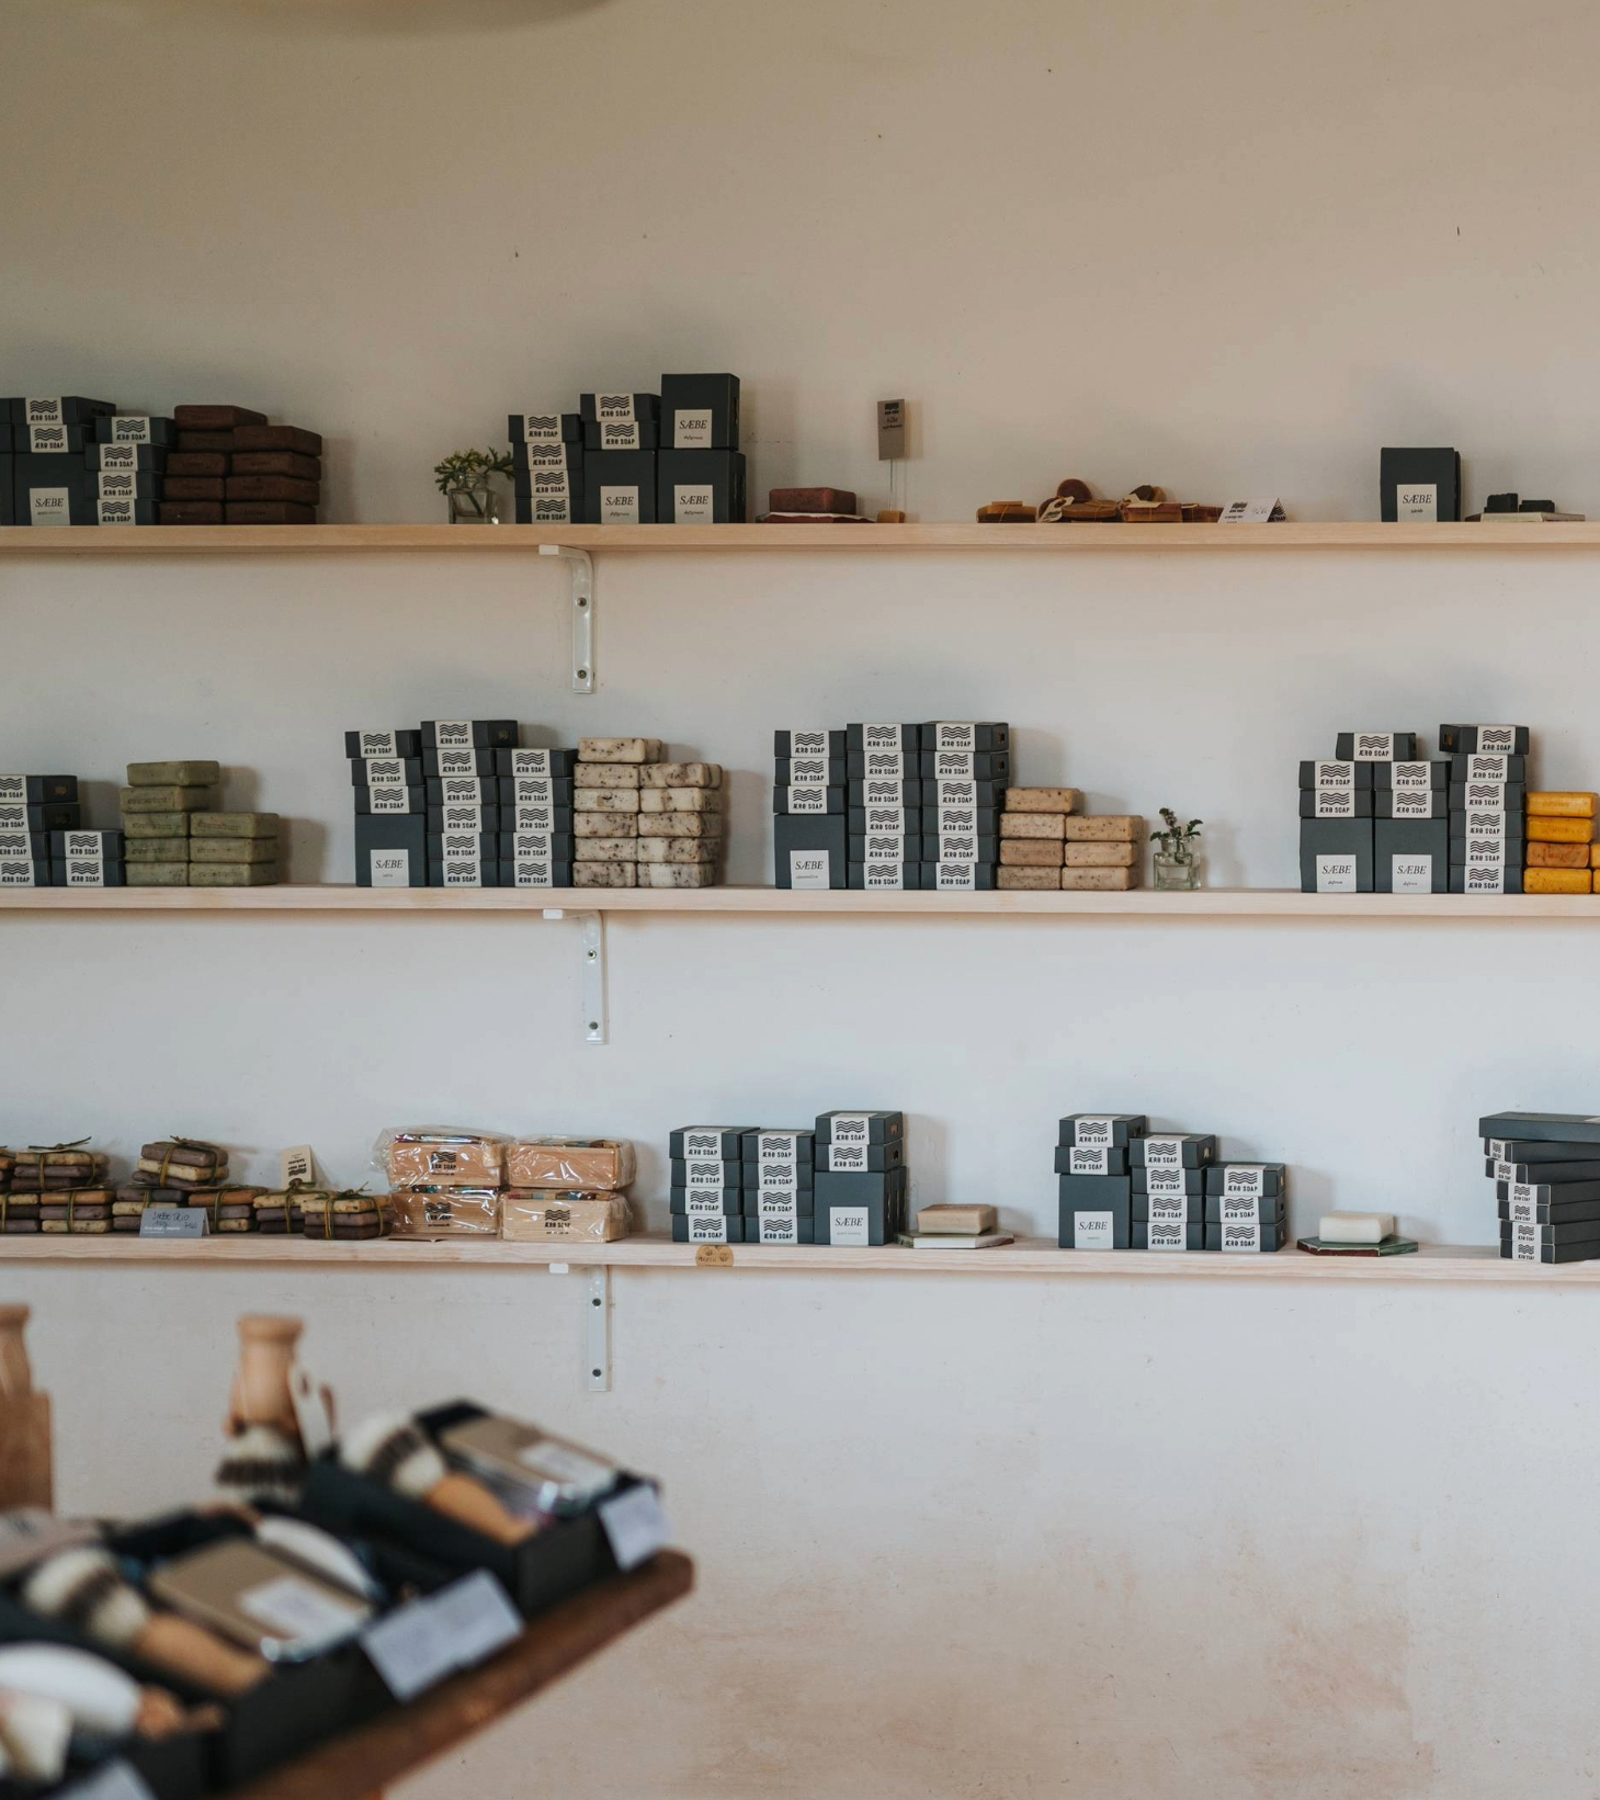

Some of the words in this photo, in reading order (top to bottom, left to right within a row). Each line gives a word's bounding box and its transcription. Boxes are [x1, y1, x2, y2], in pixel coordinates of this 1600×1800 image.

[679, 419, 708, 430] SÆBE
[543, 430, 558, 438] SOAP
[119, 460, 134, 468] SOAP
[35, 497, 64, 508] SÆBE
[605, 496, 634, 506] SÆBE
[680, 495, 709, 505] SÆBE
[1402, 494, 1432, 504] SÆBE
[551, 513, 567, 521] SOAP
[457, 765, 472, 773] SOAP
[957, 824, 973, 832] SOAP
[375, 859, 404, 869] SÆBE
[795, 860, 824, 870] SÆBE
[1322, 865, 1351, 875] SÆBE
[1398, 865, 1426, 875] SÆBE
[462, 875, 477, 883] SOAP
[835, 1217, 862, 1227] SÆBE
[1079, 1221, 1107, 1231] SÆBE
